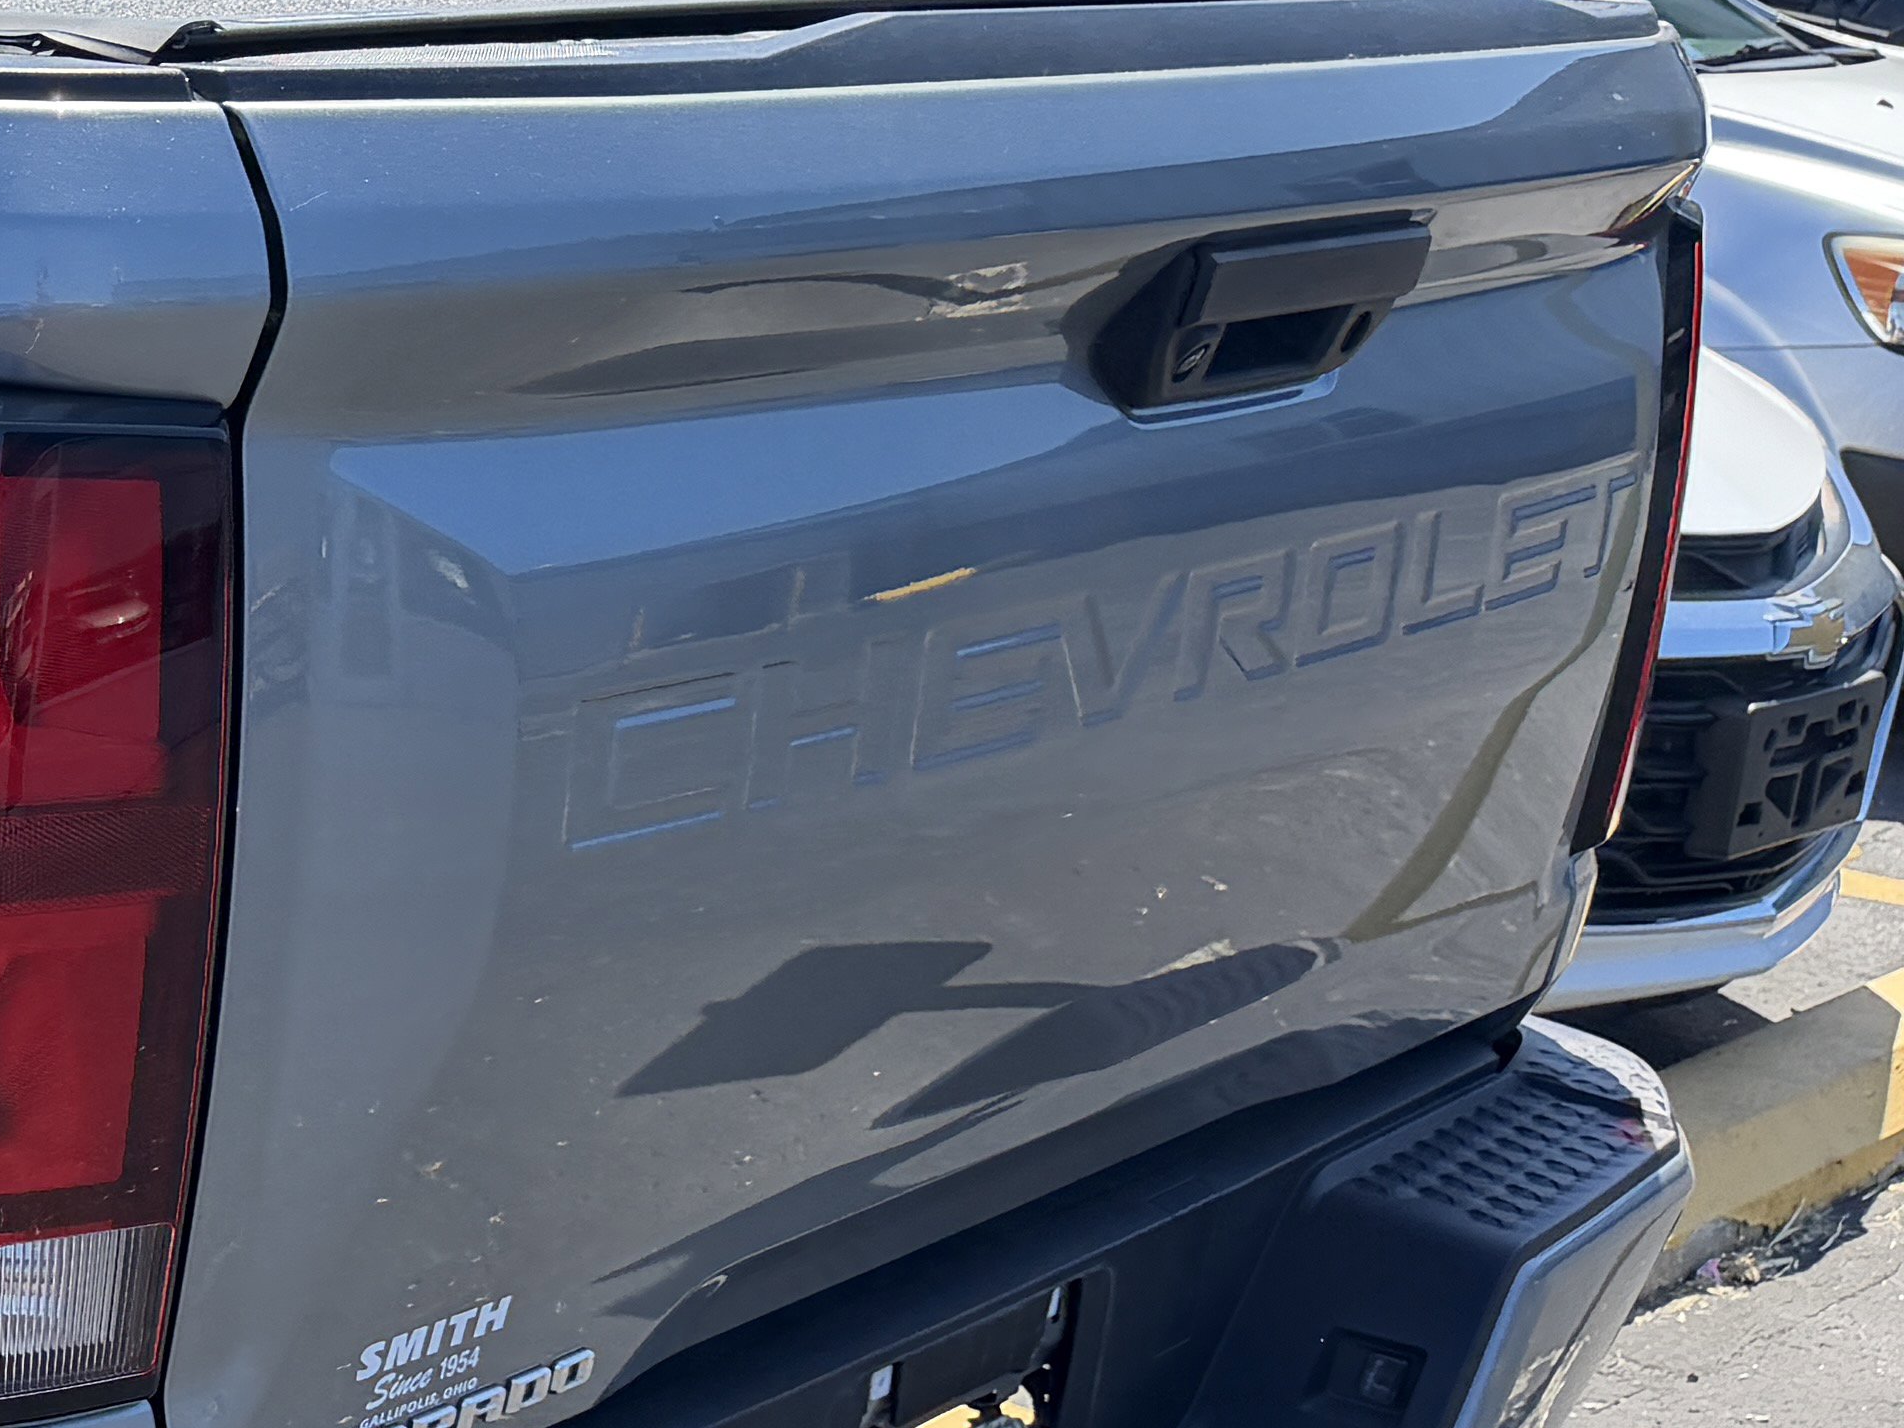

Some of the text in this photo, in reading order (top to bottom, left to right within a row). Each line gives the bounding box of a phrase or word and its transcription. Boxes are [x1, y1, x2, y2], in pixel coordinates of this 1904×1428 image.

[563, 458, 1638, 850] CHEVROLET
[356, 1295, 513, 1381] SMITH
[365, 1345, 481, 1411] Since 1954
[442, 1376, 478, 1399] OHIO
